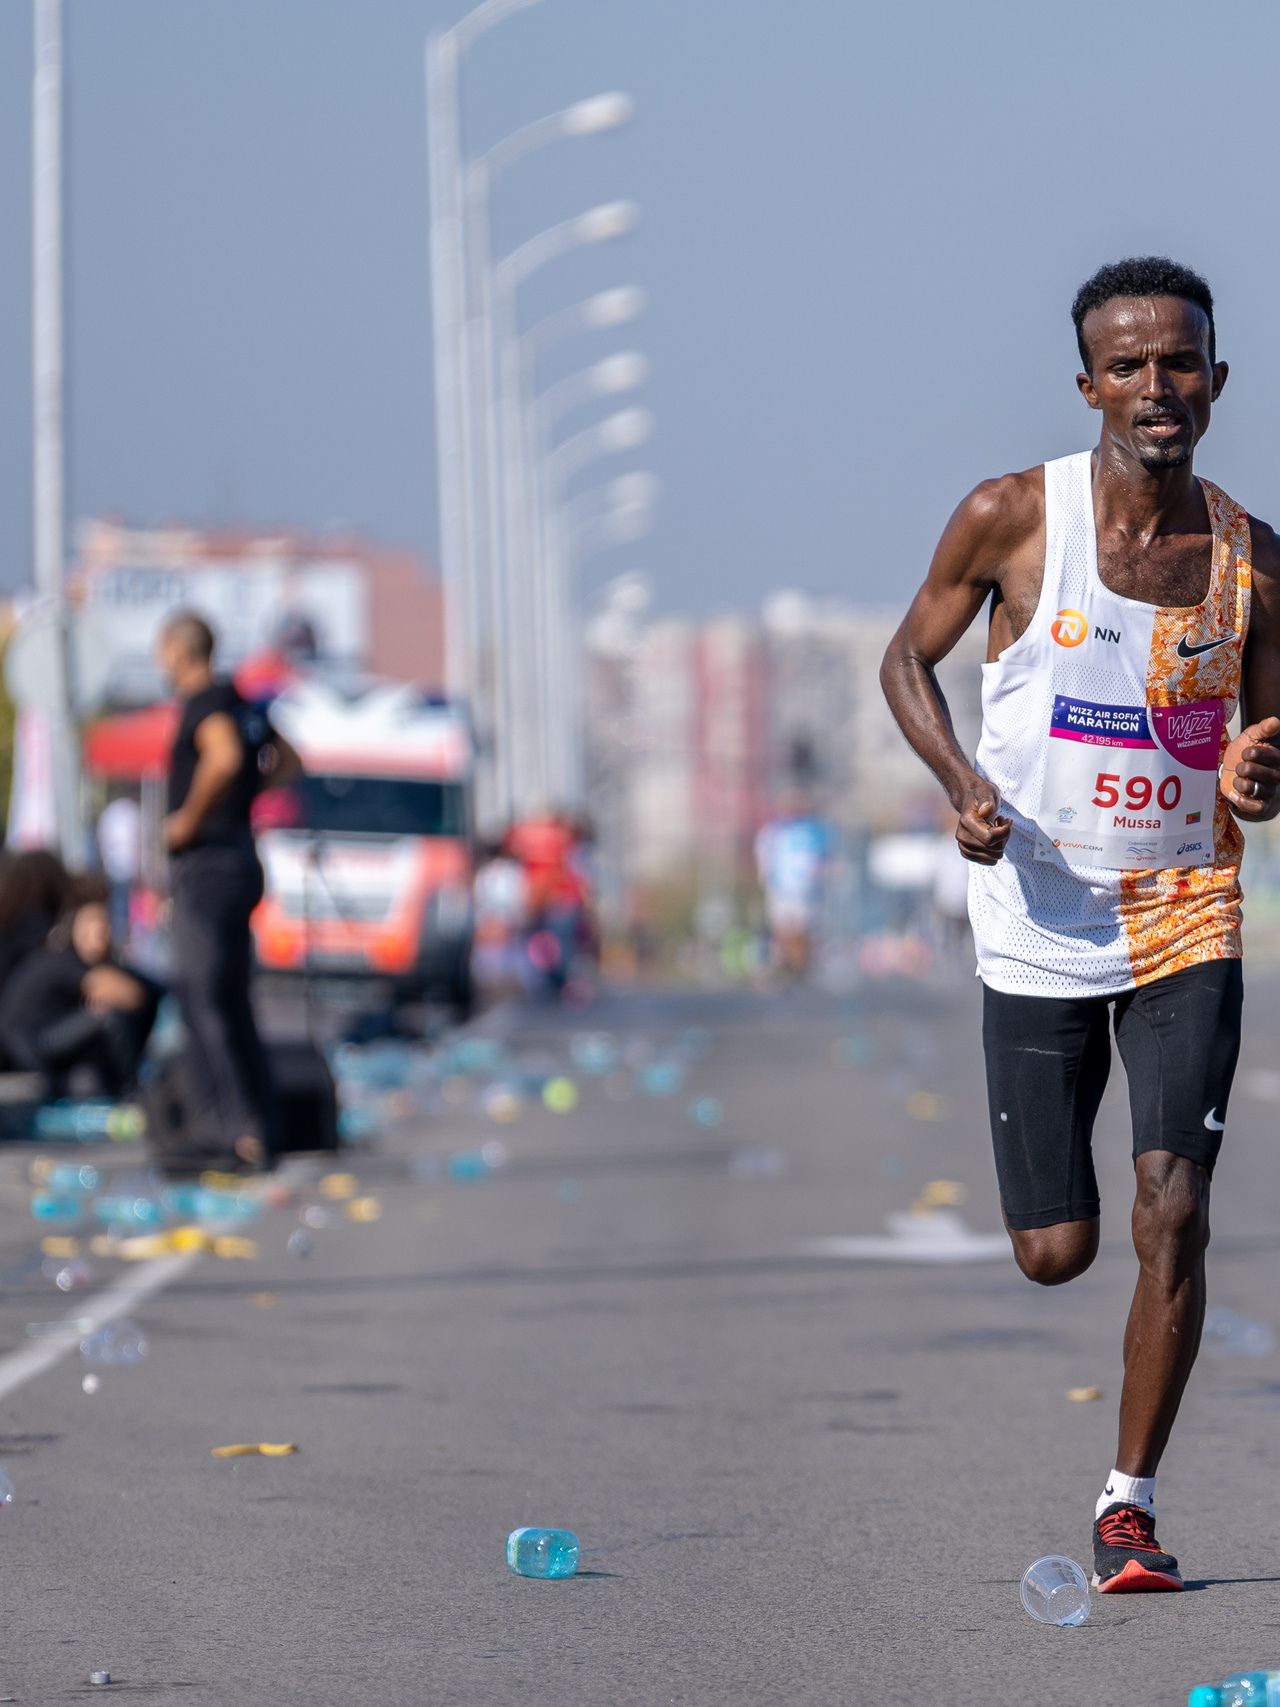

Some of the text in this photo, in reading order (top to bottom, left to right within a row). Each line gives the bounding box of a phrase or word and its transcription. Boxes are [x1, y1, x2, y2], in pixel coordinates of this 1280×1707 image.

[1094, 626, 1121, 644] NN
[1069, 705, 1140, 721] WIZZ AIR SOFIA
[1067, 713, 1139, 732] MARATHON
[1081, 734, 1111, 746] 42.195
[1177, 736, 1211, 748] wizzair.com
[1091, 772, 1182, 811] 590
[1113, 815, 1162, 829] Mussa
[1062, 842, 1103, 852] VIVACOM
